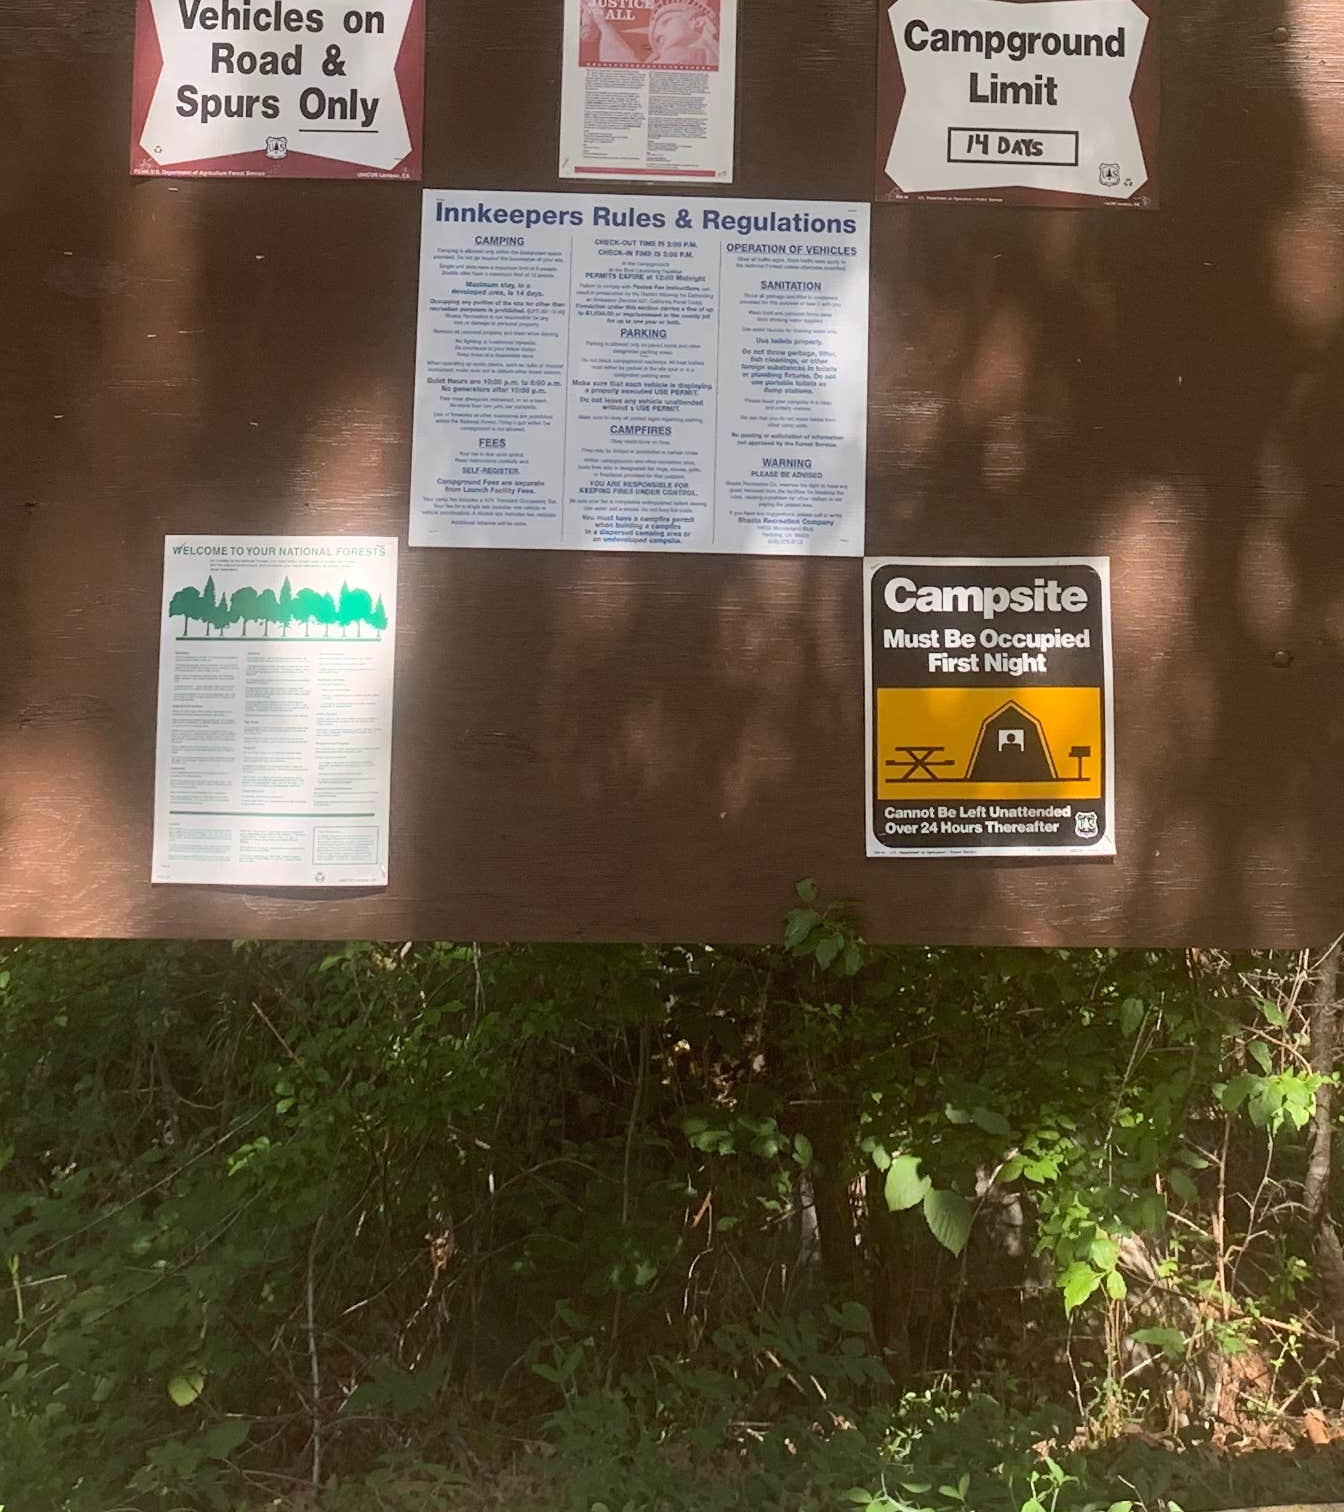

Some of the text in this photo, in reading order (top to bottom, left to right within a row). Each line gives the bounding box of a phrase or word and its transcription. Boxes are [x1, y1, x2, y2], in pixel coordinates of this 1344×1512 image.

[606, 9, 635, 21] ALL
[343, 10, 385, 34] on
[904, 19, 1125, 61] Campground
[211, 42, 346, 76] Road &
[969, 72, 1058, 106] Limit
[176, 84, 380, 128] Spurs Only
[966, 134, 1043, 157] 14 DAYS
[435, 201, 857, 235] Innkeepers Rules & Regulations
[475, 235, 525, 246] CAMPING
[594, 239, 636, 247] CHECK-OUT
[726, 243, 857, 256] OPERATION OF VEHICLES
[761, 280, 822, 290] SANITATION
[620, 328, 667, 338] PARKING
[610, 425, 672, 436] CAMPFIRES
[479, 438, 506, 448] FEES
[762, 458, 812, 468] WARNING
[172, 545, 386, 557] WELCOME TO YOUR NATIONAL FORESTS
[884, 577, 1088, 620] Campsite
[883, 629, 1090, 649] Must Be Occupied
[928, 653, 1047, 676] First Night
[884, 805, 1072, 819] Cannot Be Left Unattended
[885, 821, 1060, 834] Over 24 Hours Thereafter
